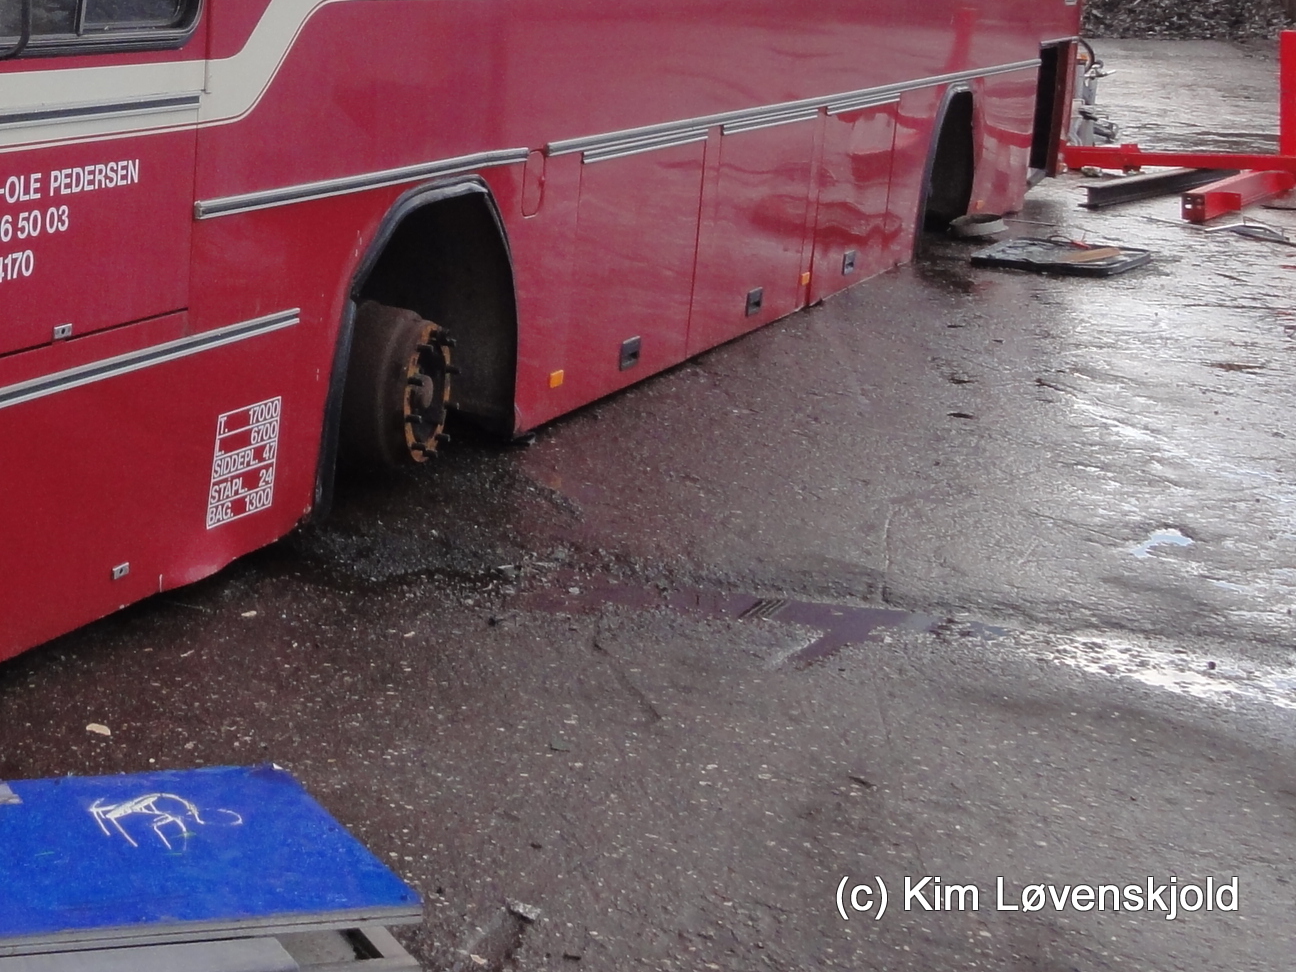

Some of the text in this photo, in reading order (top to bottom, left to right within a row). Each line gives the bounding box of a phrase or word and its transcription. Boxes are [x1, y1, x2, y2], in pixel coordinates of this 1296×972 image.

[49, 159, 140, 196] PEDERSEN
[17, 209, 41, 239] 50
[46, 205, 69, 234] 03
[219, 399, 279, 435] T. 17000
[215, 421, 278, 456] L. 6700
[213, 441, 276, 478] SIDDEPL. 47
[258, 466, 273, 487] 24
[208, 488, 272, 524] BAG. 1300
